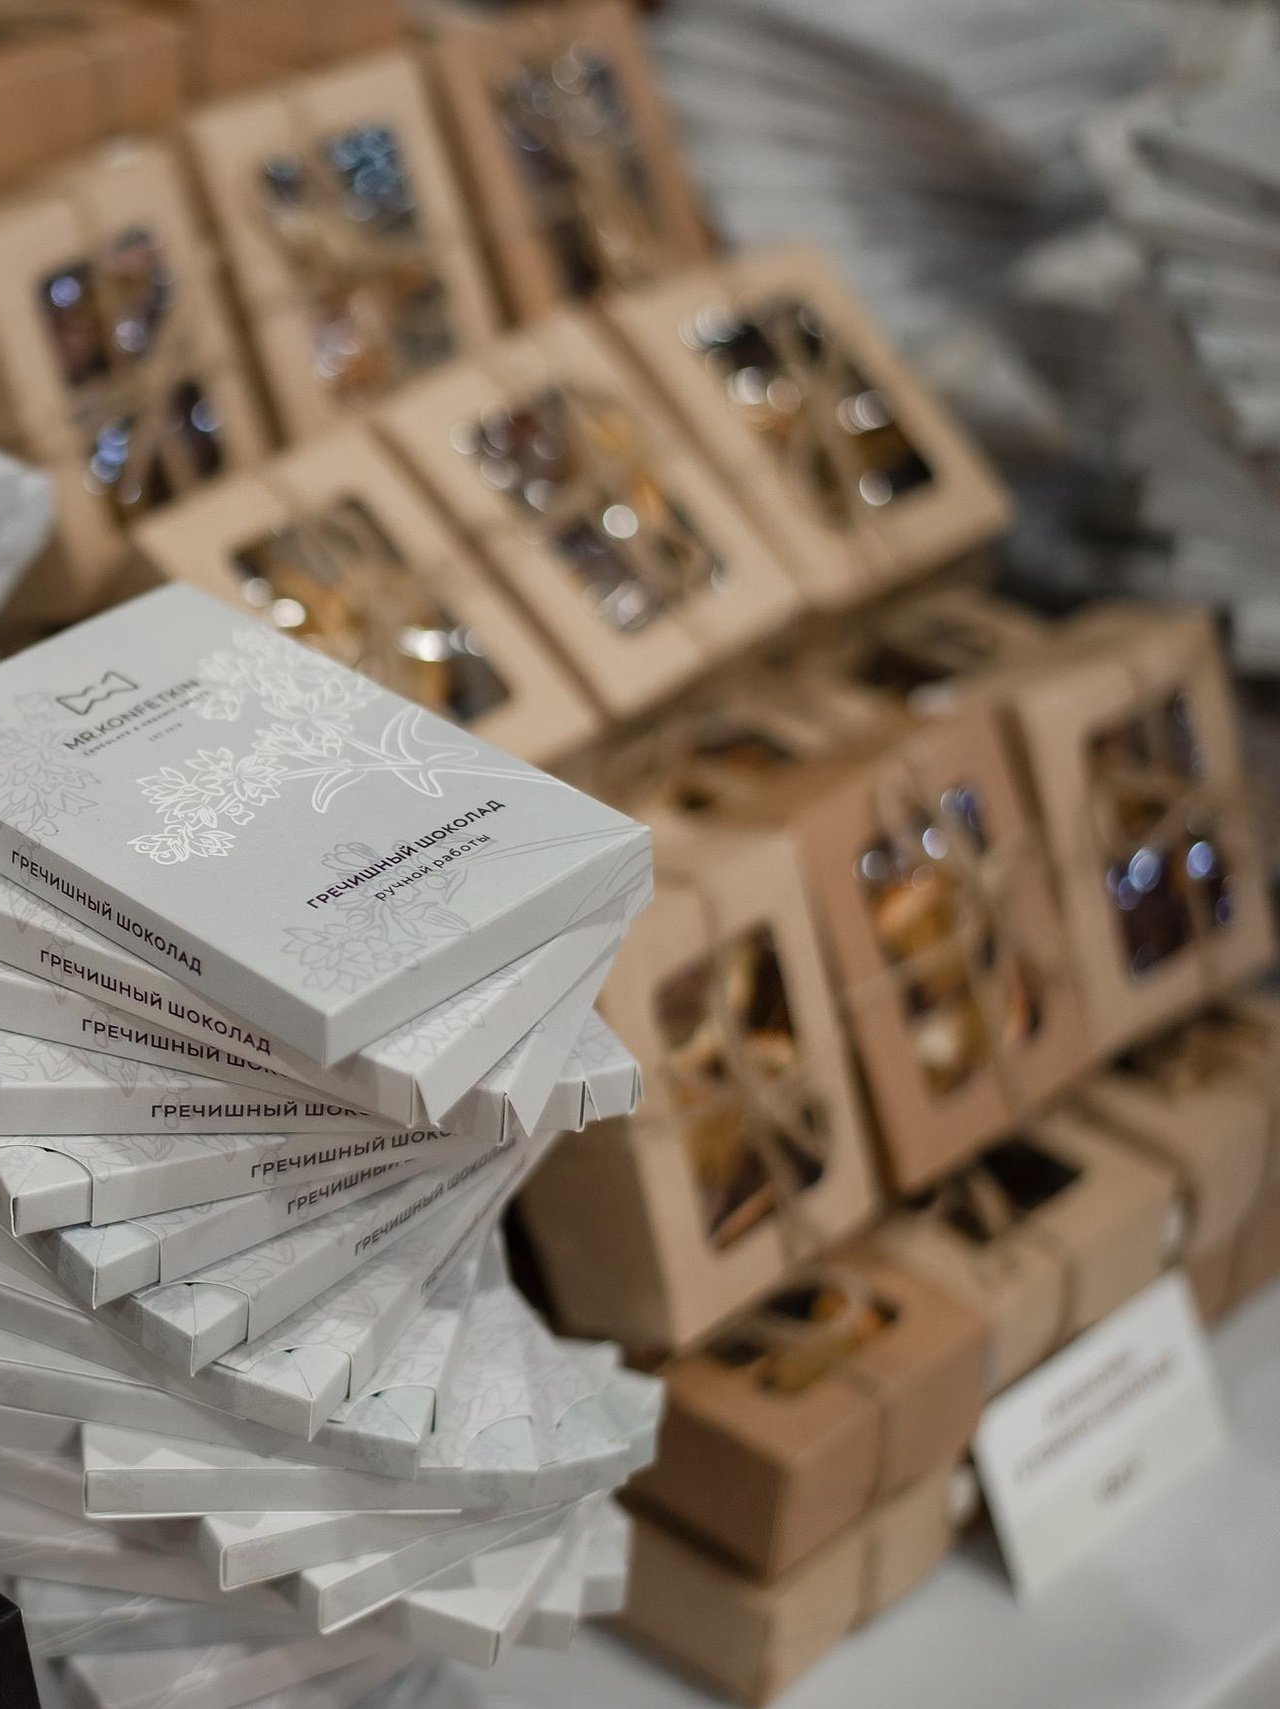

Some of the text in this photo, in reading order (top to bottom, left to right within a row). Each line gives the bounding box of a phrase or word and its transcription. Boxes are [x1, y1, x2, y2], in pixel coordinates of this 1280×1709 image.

[306, 799, 506, 909] ГРЕЧИШНЫЙ ШОКОЛАД
[374, 833, 491, 902] ручной работы
[10, 850, 202, 977] ГРЕЧИШНЫЙ ШОКОЛАД
[40, 949, 271, 1056] ГРЕЧИШНЫЙ ШОКОЛАД
[82, 1017, 220, 1063] ГРЕЧИШНЫЙ
[151, 1100, 298, 1118] ГРЕЧИШНЫЙ
[250, 1136, 385, 1178] ГРЕЧИШНЫЙ
